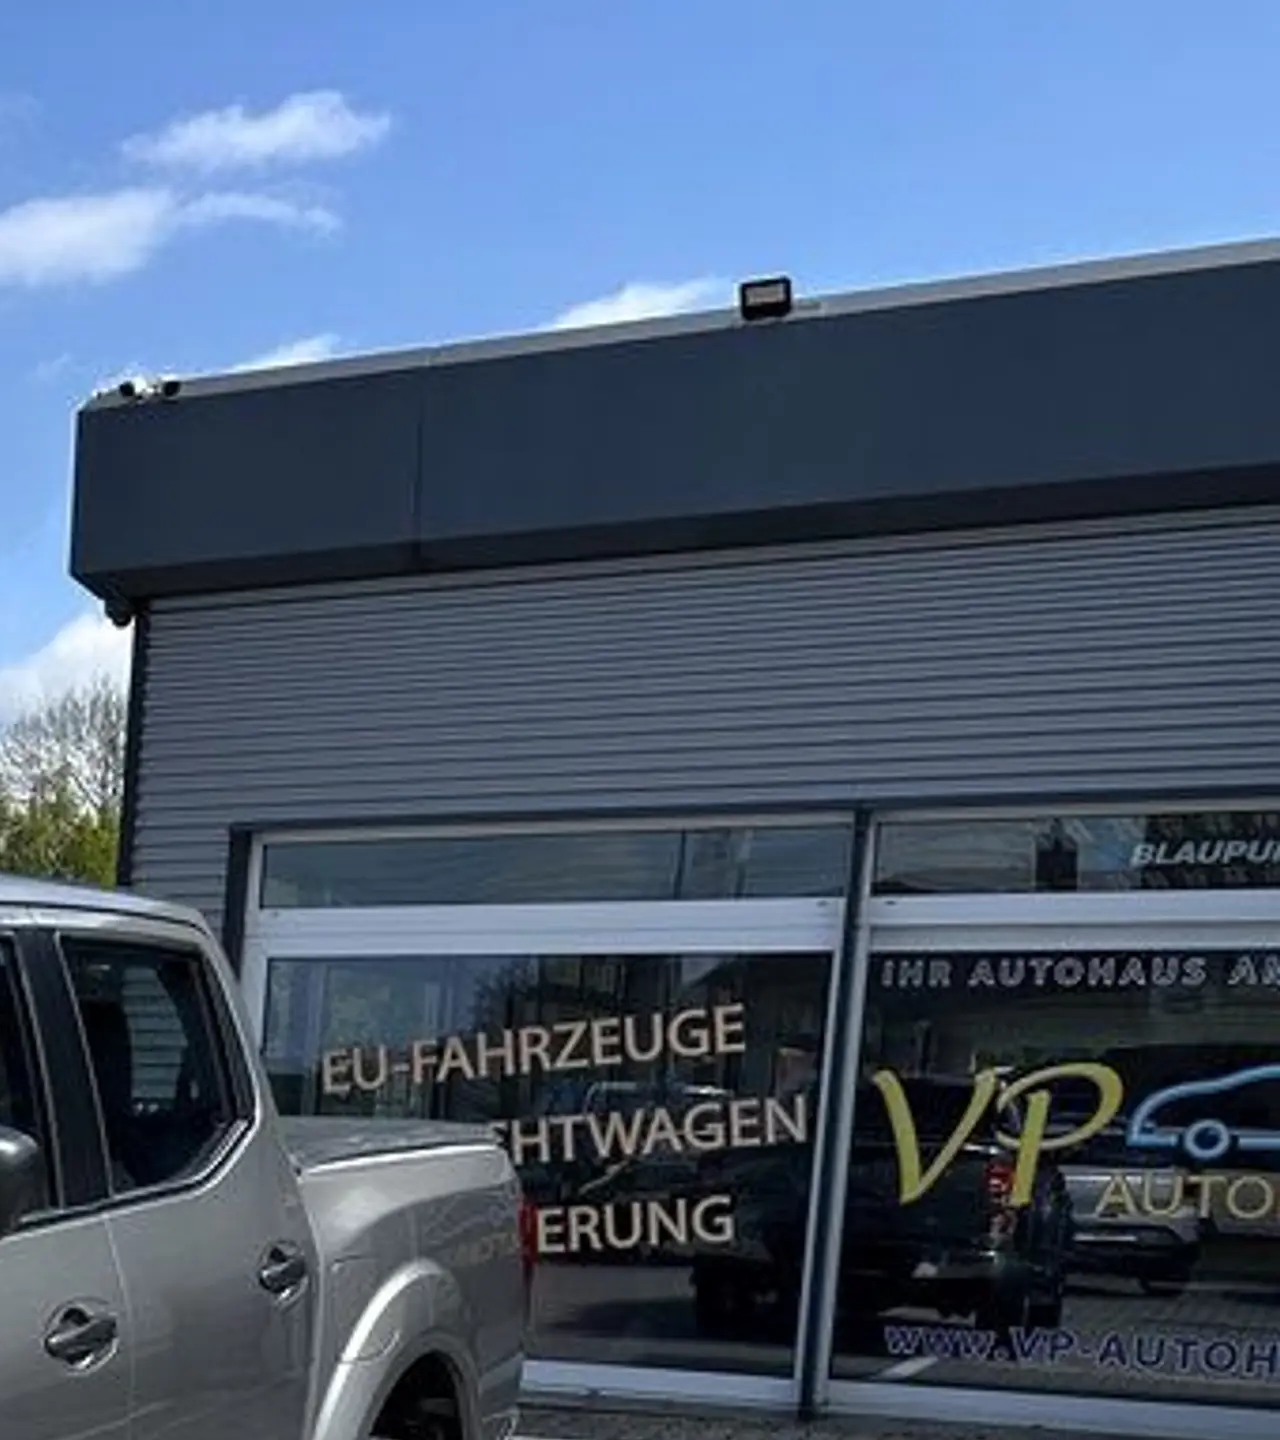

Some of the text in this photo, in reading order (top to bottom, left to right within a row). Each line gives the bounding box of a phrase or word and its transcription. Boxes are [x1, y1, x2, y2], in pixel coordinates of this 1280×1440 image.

[881, 959, 951, 987] IHR
[967, 957, 1207, 987] AUTOHAUS
[322, 1004, 746, 1095] EU-FAHRZEUGE
[871, 1061, 1124, 1208] VP
[537, 1196, 735, 1254] ERUNG
[1093, 1173, 1274, 1220] AUTO
